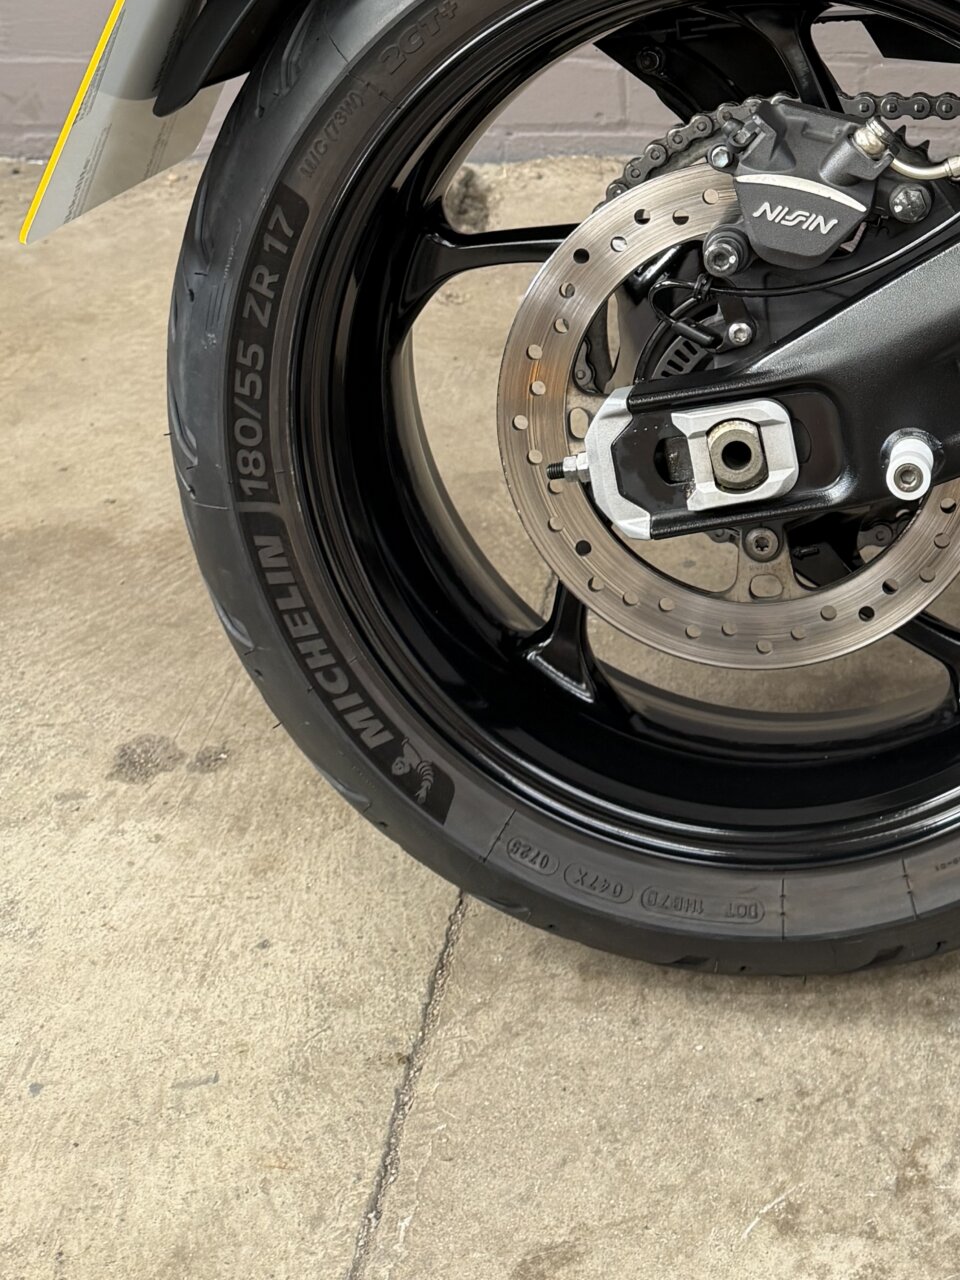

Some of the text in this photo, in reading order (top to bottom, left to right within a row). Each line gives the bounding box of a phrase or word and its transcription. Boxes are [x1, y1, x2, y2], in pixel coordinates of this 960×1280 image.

[752, 201, 838, 235] NISSIN
[236, 206, 295, 496] 180/55 ZR 17
[254, 536, 394, 749] MICHELIN
[725, 900, 757, 919] DOT
